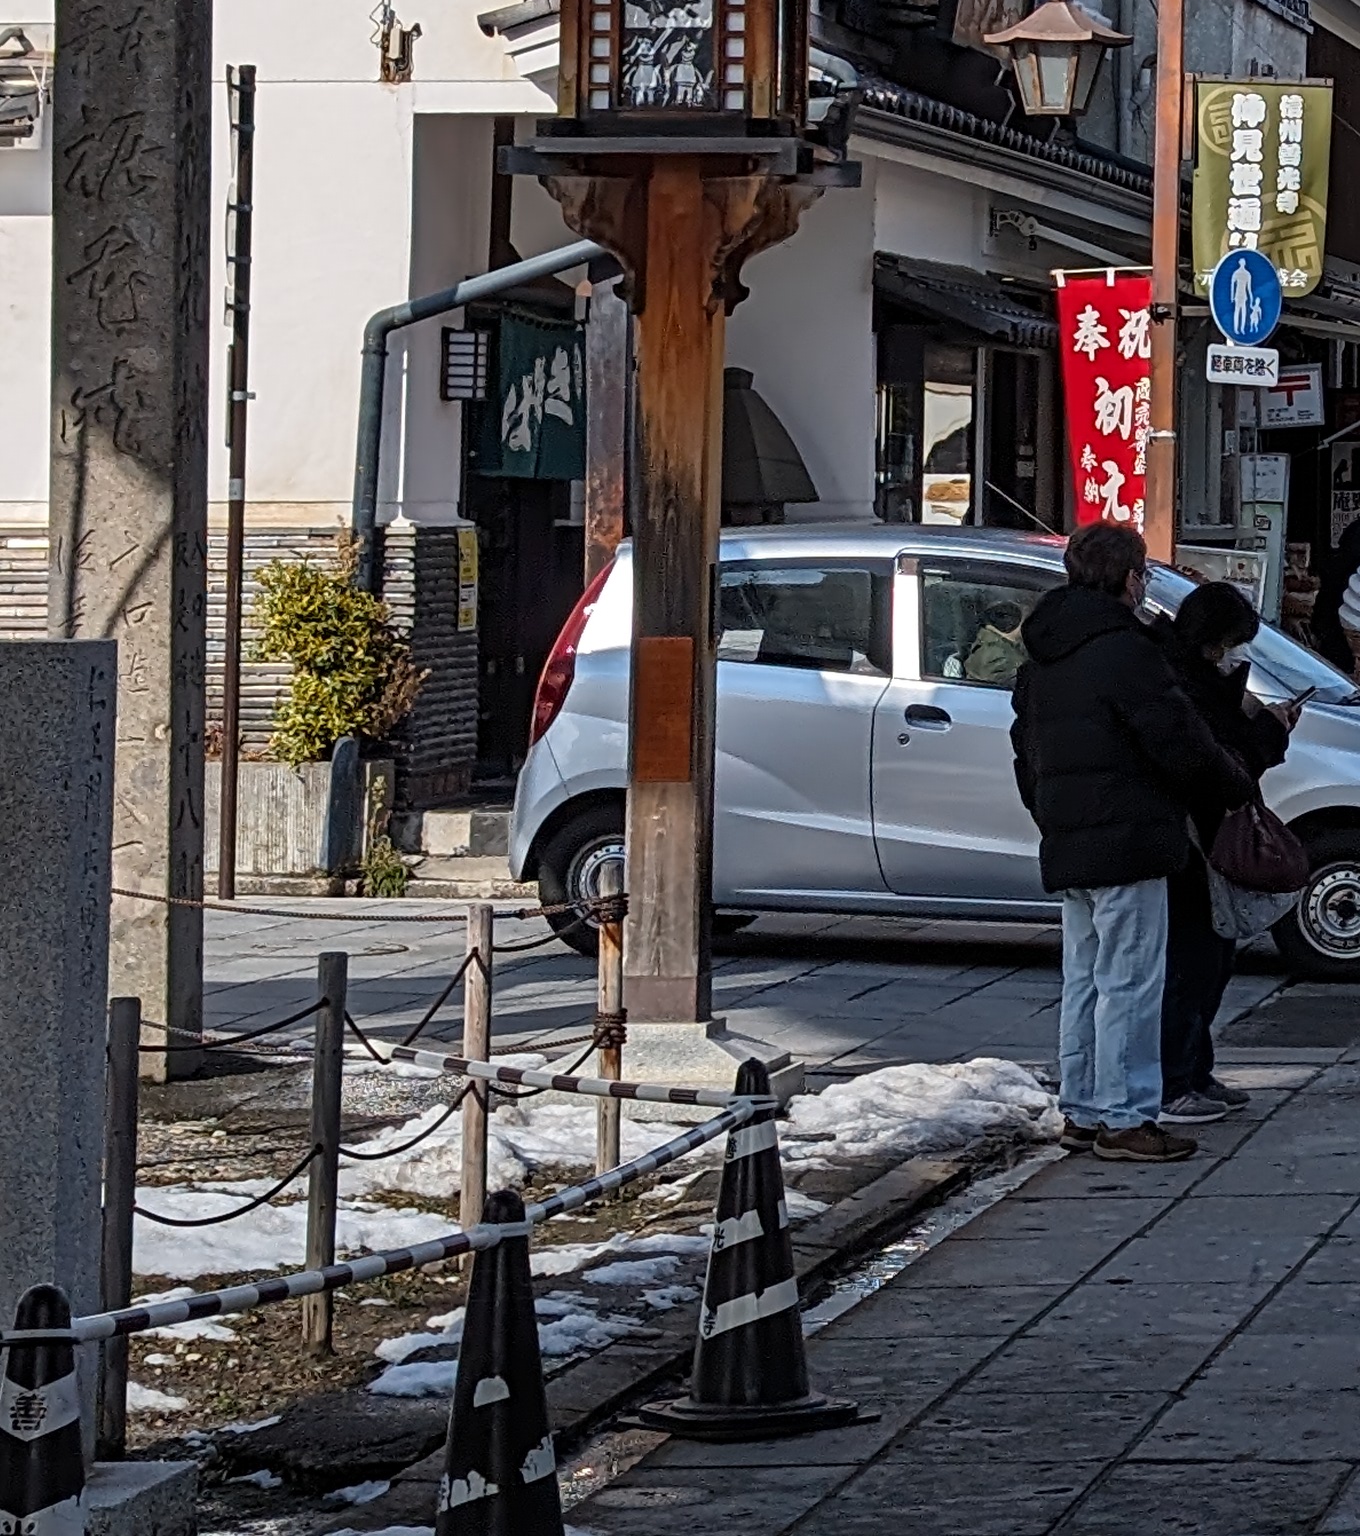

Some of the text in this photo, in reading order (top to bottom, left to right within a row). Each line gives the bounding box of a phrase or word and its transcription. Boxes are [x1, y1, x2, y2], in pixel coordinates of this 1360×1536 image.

[1275, 94, 1305, 214] 信州善光寺
[1210, 353, 1275, 378] 軽車両を除く
